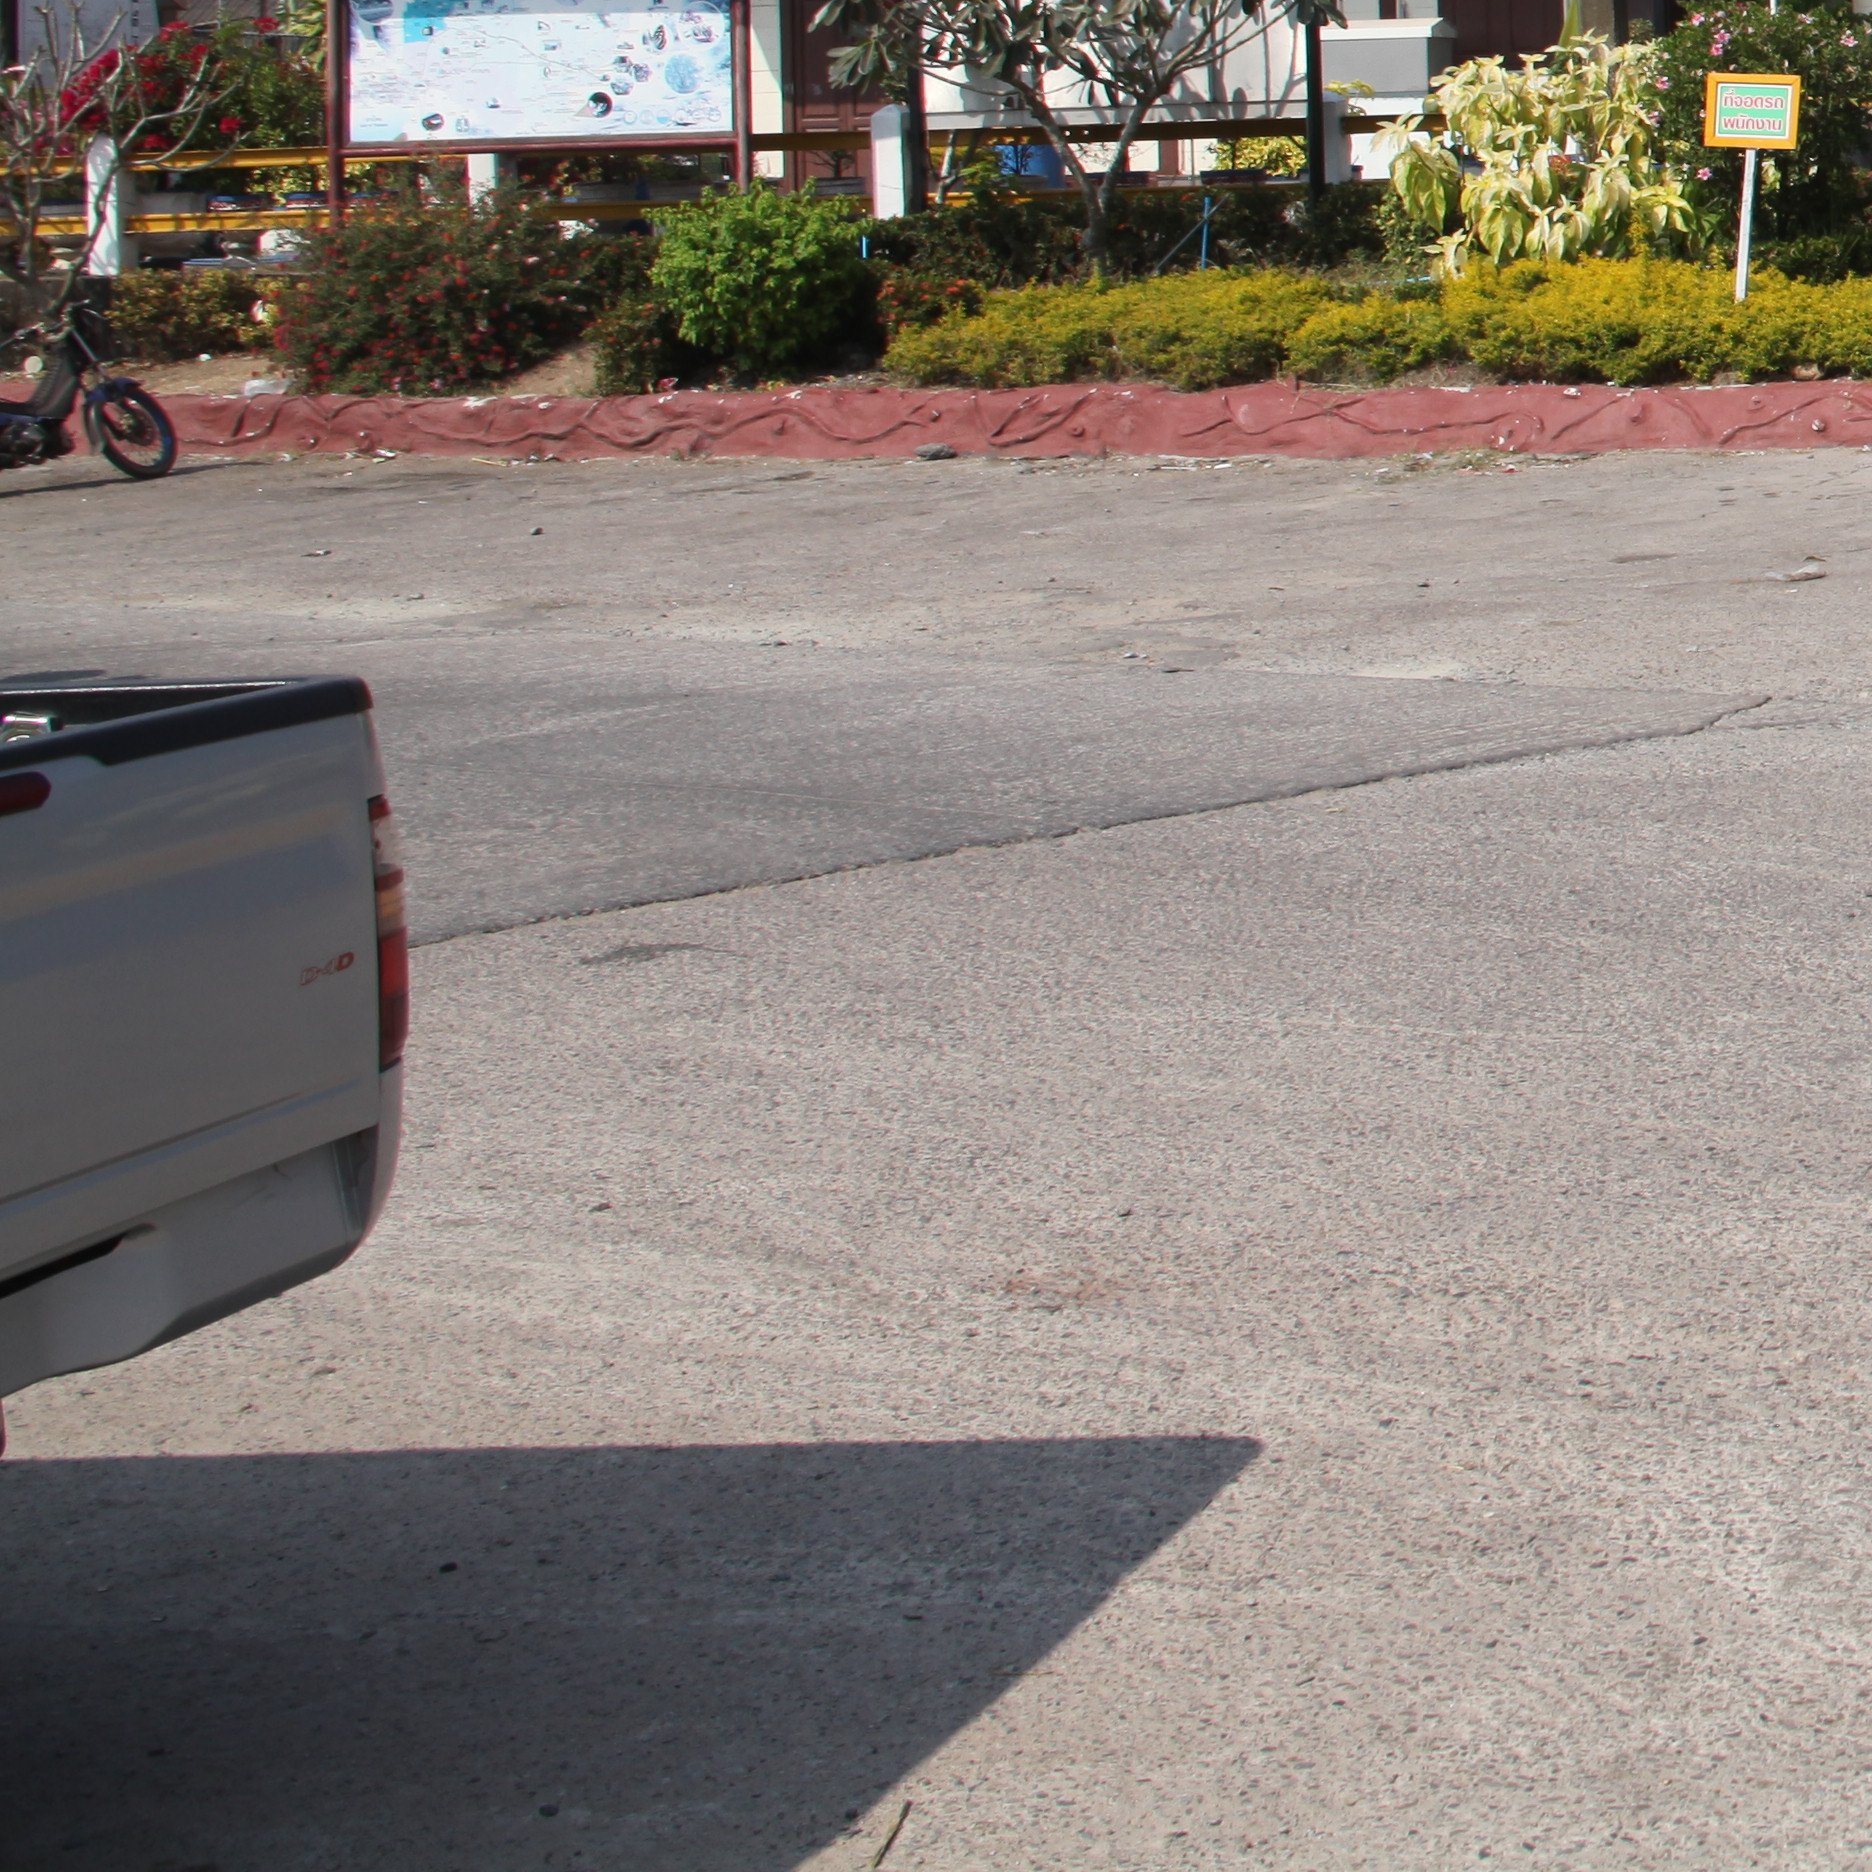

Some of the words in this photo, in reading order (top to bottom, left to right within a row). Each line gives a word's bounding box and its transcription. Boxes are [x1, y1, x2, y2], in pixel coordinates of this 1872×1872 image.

[1723, 89, 1785, 109] ที่จอดรถ
[1723, 114, 1783, 131] พนักงาน
